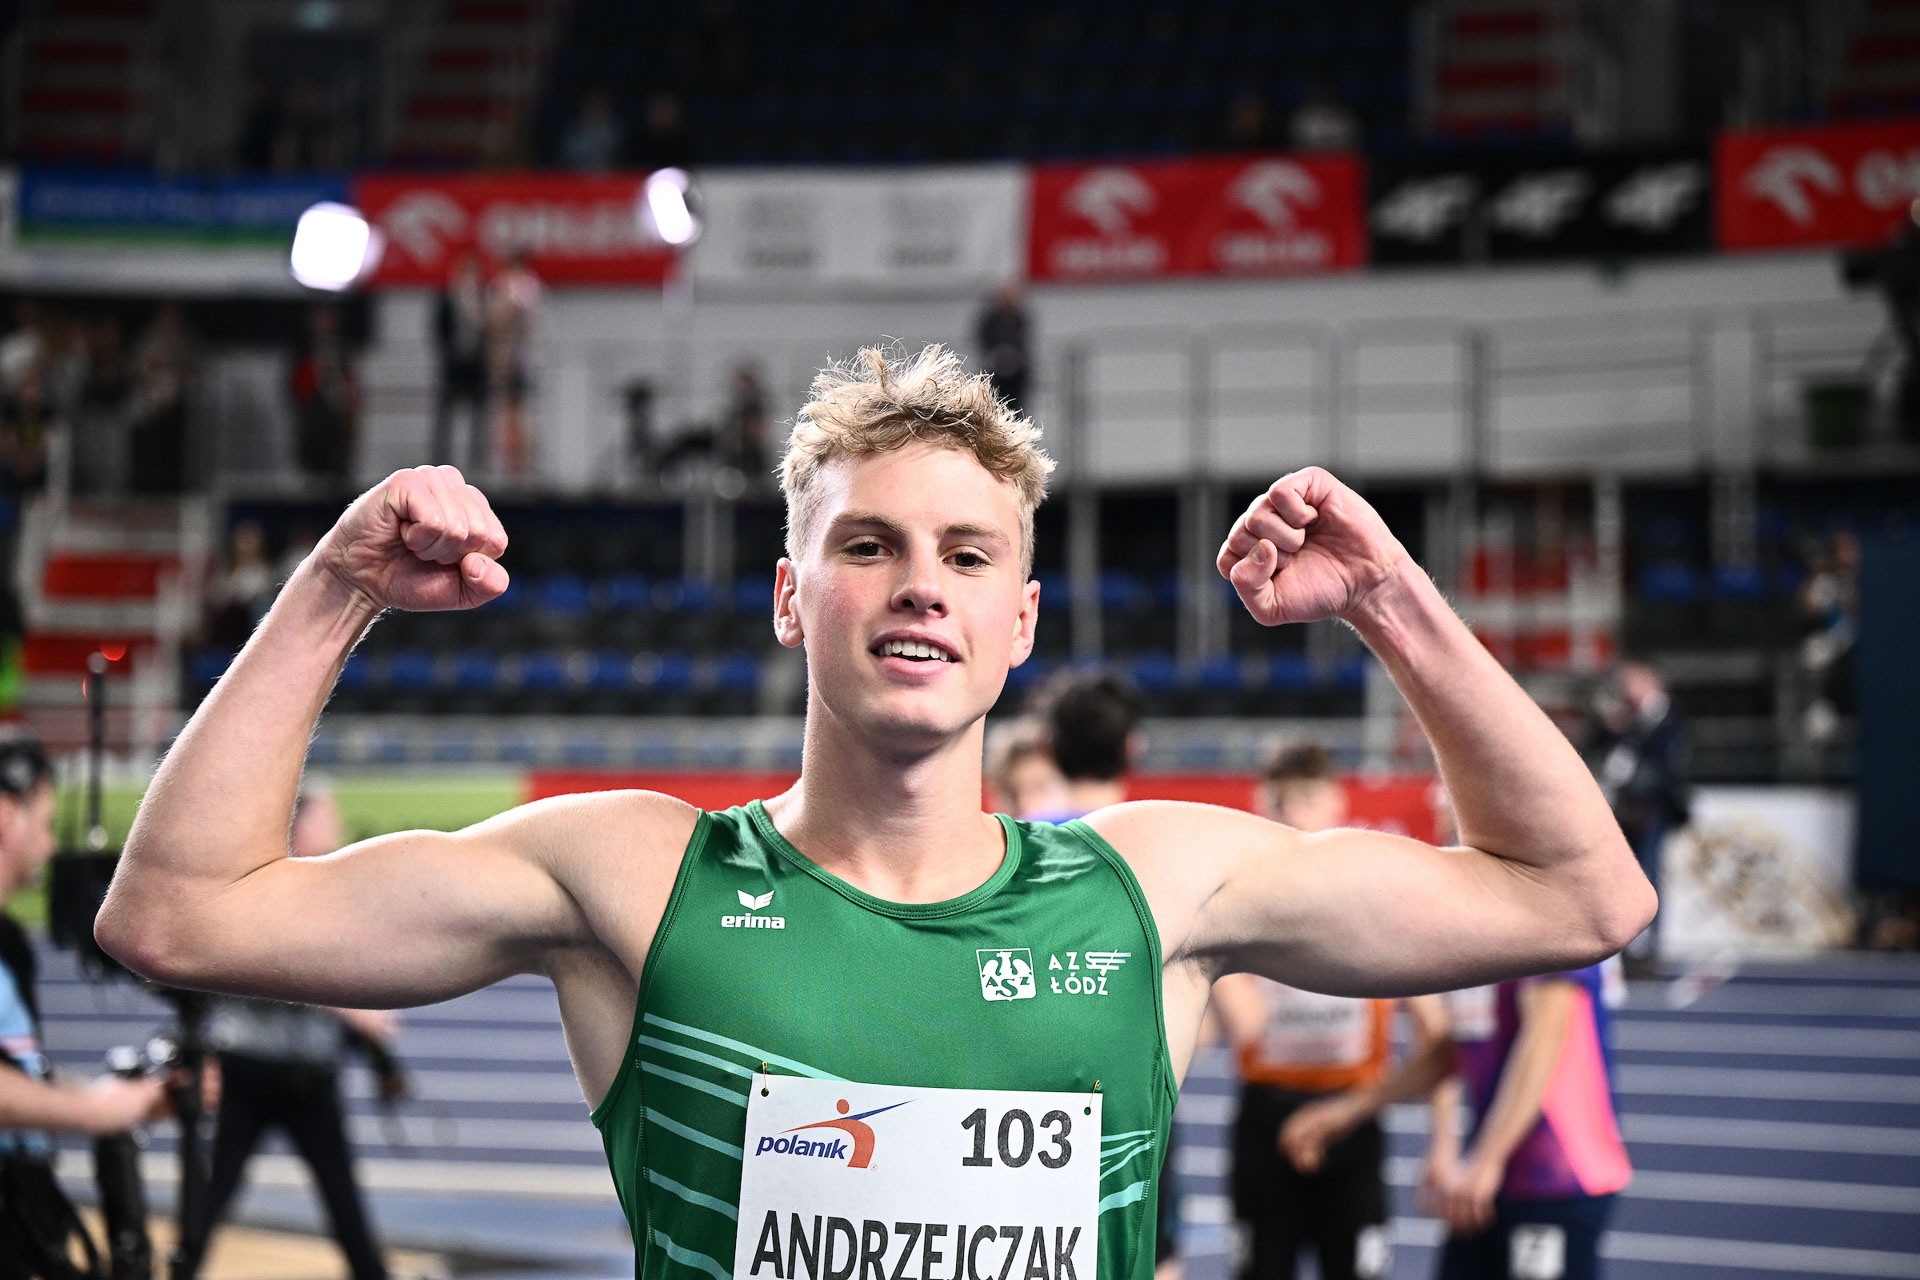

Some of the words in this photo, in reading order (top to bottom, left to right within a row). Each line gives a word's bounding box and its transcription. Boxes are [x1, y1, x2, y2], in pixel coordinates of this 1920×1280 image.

[721, 913, 785, 929] erima
[755, 1134, 848, 1160] polanik
[961, 1108, 1072, 1169] 103
[750, 1210, 1082, 1280] ANDRZEJCZAK
